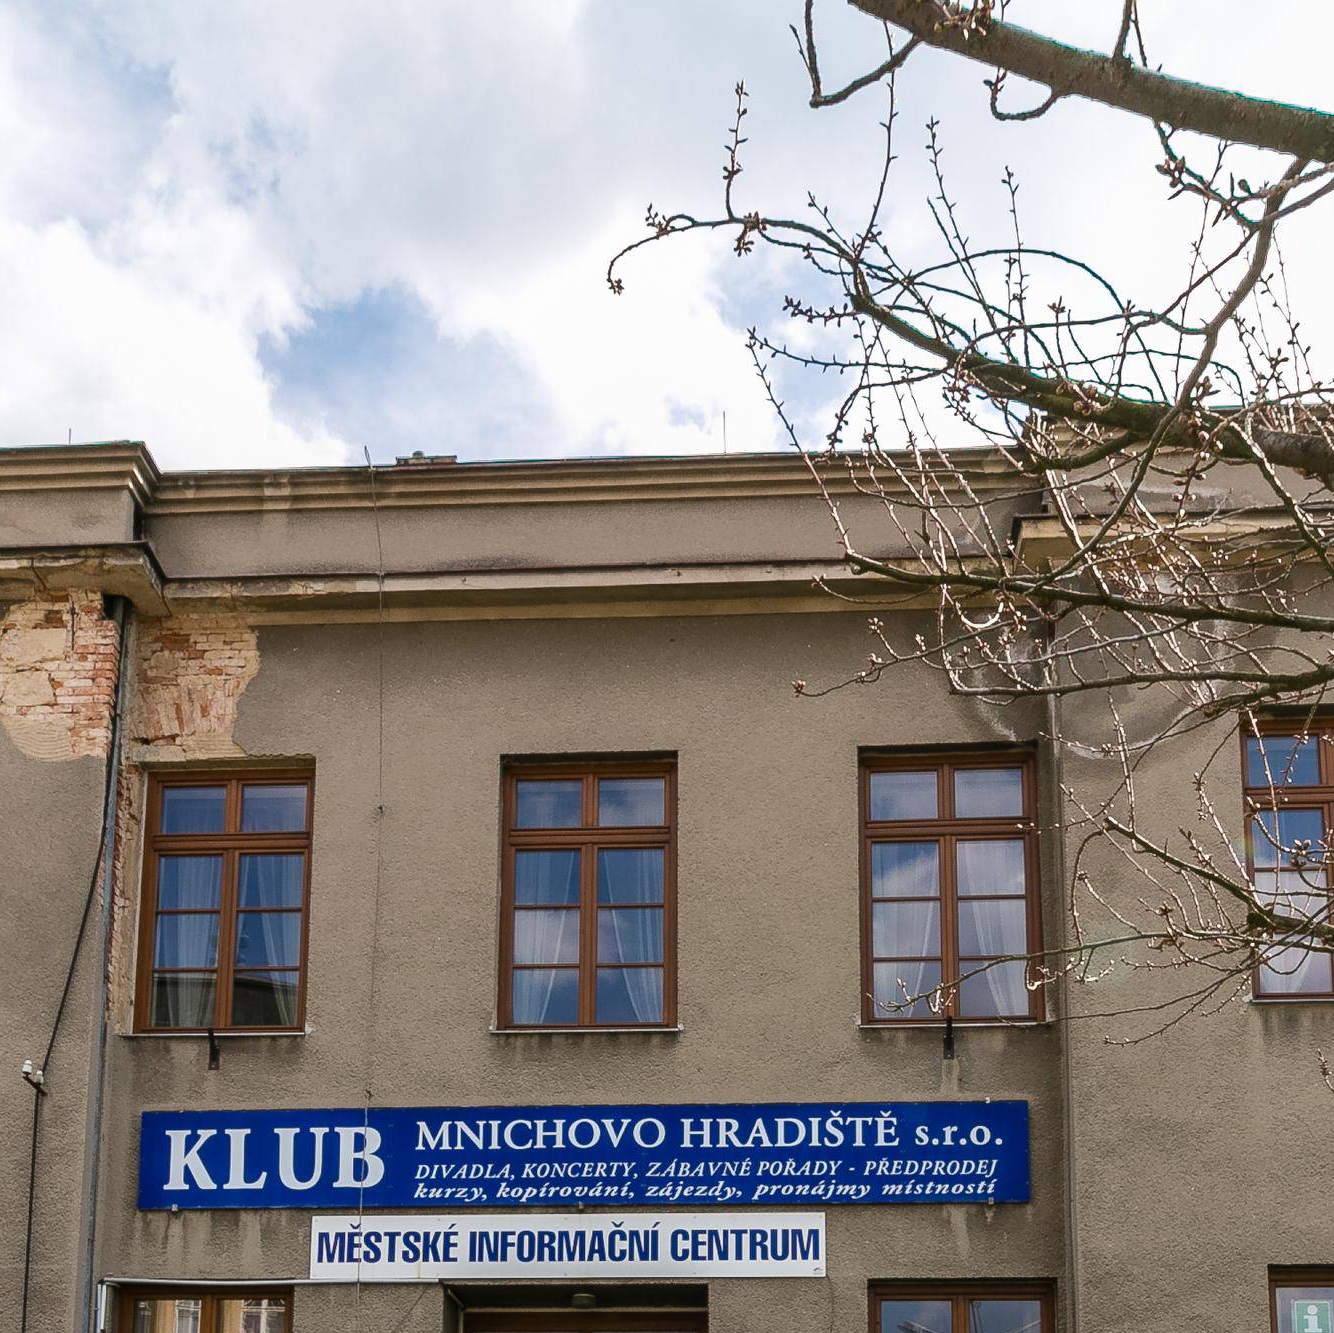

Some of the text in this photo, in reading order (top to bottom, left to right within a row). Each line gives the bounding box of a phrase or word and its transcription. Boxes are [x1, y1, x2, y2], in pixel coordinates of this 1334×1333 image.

[415, 1110, 1003, 1151] MNICHOVO HRADIŠTĚ s.r.o.
[163, 1126, 385, 1190] KLUB
[415, 1162, 515, 1180] DIVADLA,
[521, 1161, 639, 1179] KONCERTY,
[645, 1158, 752, 1178] ZÁBAVNÉ
[756, 1158, 842, 1177] POŘADY
[864, 1157, 998, 1178] PŘEDPRODEJ
[414, 1179, 997, 1202] kurzy, kopírování, zájezdy, pronájmy místností
[317, 1221, 820, 1264] MĚSTSKÉ INFORMAČNÍ CENTRUM
